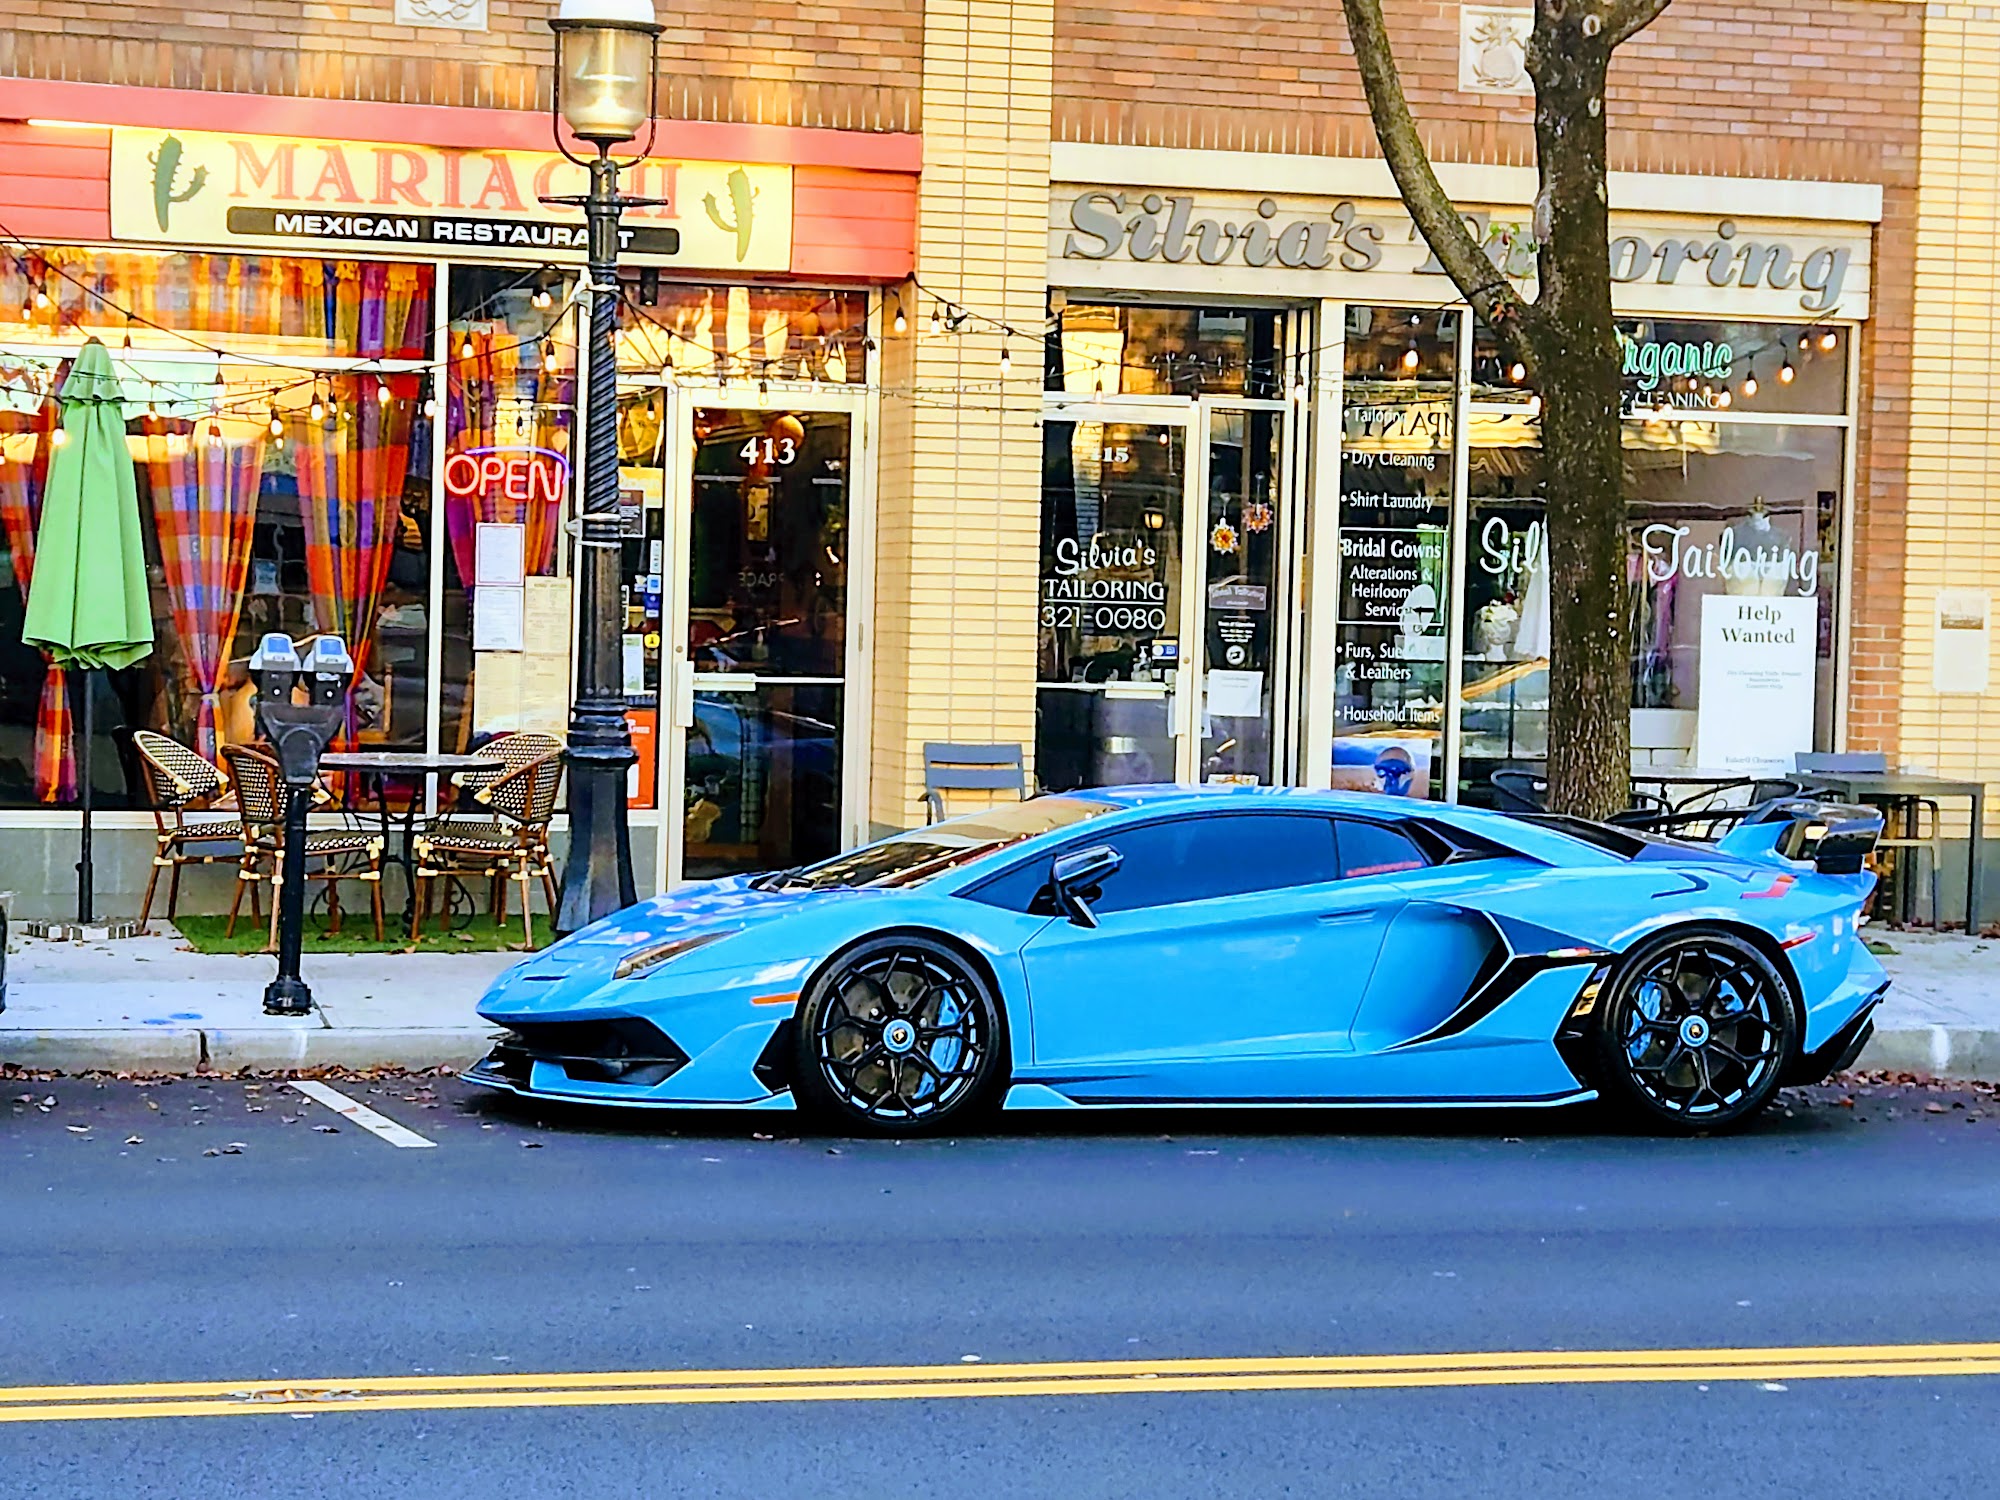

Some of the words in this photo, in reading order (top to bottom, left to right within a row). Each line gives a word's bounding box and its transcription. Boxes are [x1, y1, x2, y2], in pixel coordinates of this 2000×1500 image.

[275, 213, 418, 239] MEXICAN
[433, 221, 635, 250] RESTAURAT
[1063, 190, 1384, 272] Silvia's
[1408, 210, 1852, 311] aoring
[1613, 325, 1733, 390] rganic
[740, 436, 796, 466] 413
[1352, 449, 1376, 469] Dry
[1379, 451, 1436, 471] Cleaning
[444, 453, 563, 502] OPEN
[1350, 489, 1379, 508] Shirt
[1383, 491, 1434, 514] Laundry
[1054, 537, 1156, 576] Silvia's
[1341, 537, 1386, 558] Bridal
[1390, 539, 1442, 559] Gowns
[1642, 523, 1819, 597] Tailoring
[1349, 563, 1418, 581] Alterations
[1044, 579, 1165, 600] TAILORING
[1041, 606, 1167, 630] 321-0080
[1738, 604, 1782, 625] Help
[1721, 627, 1796, 644] Wanted
[1345, 641, 1376, 661] Furs,
[1379, 642, 1404, 660] Sue
[1345, 663, 1357, 680] &
[1360, 663, 1412, 681] Leathers
[1343, 704, 1406, 723] Household
[1409, 707, 1441, 724] Items
